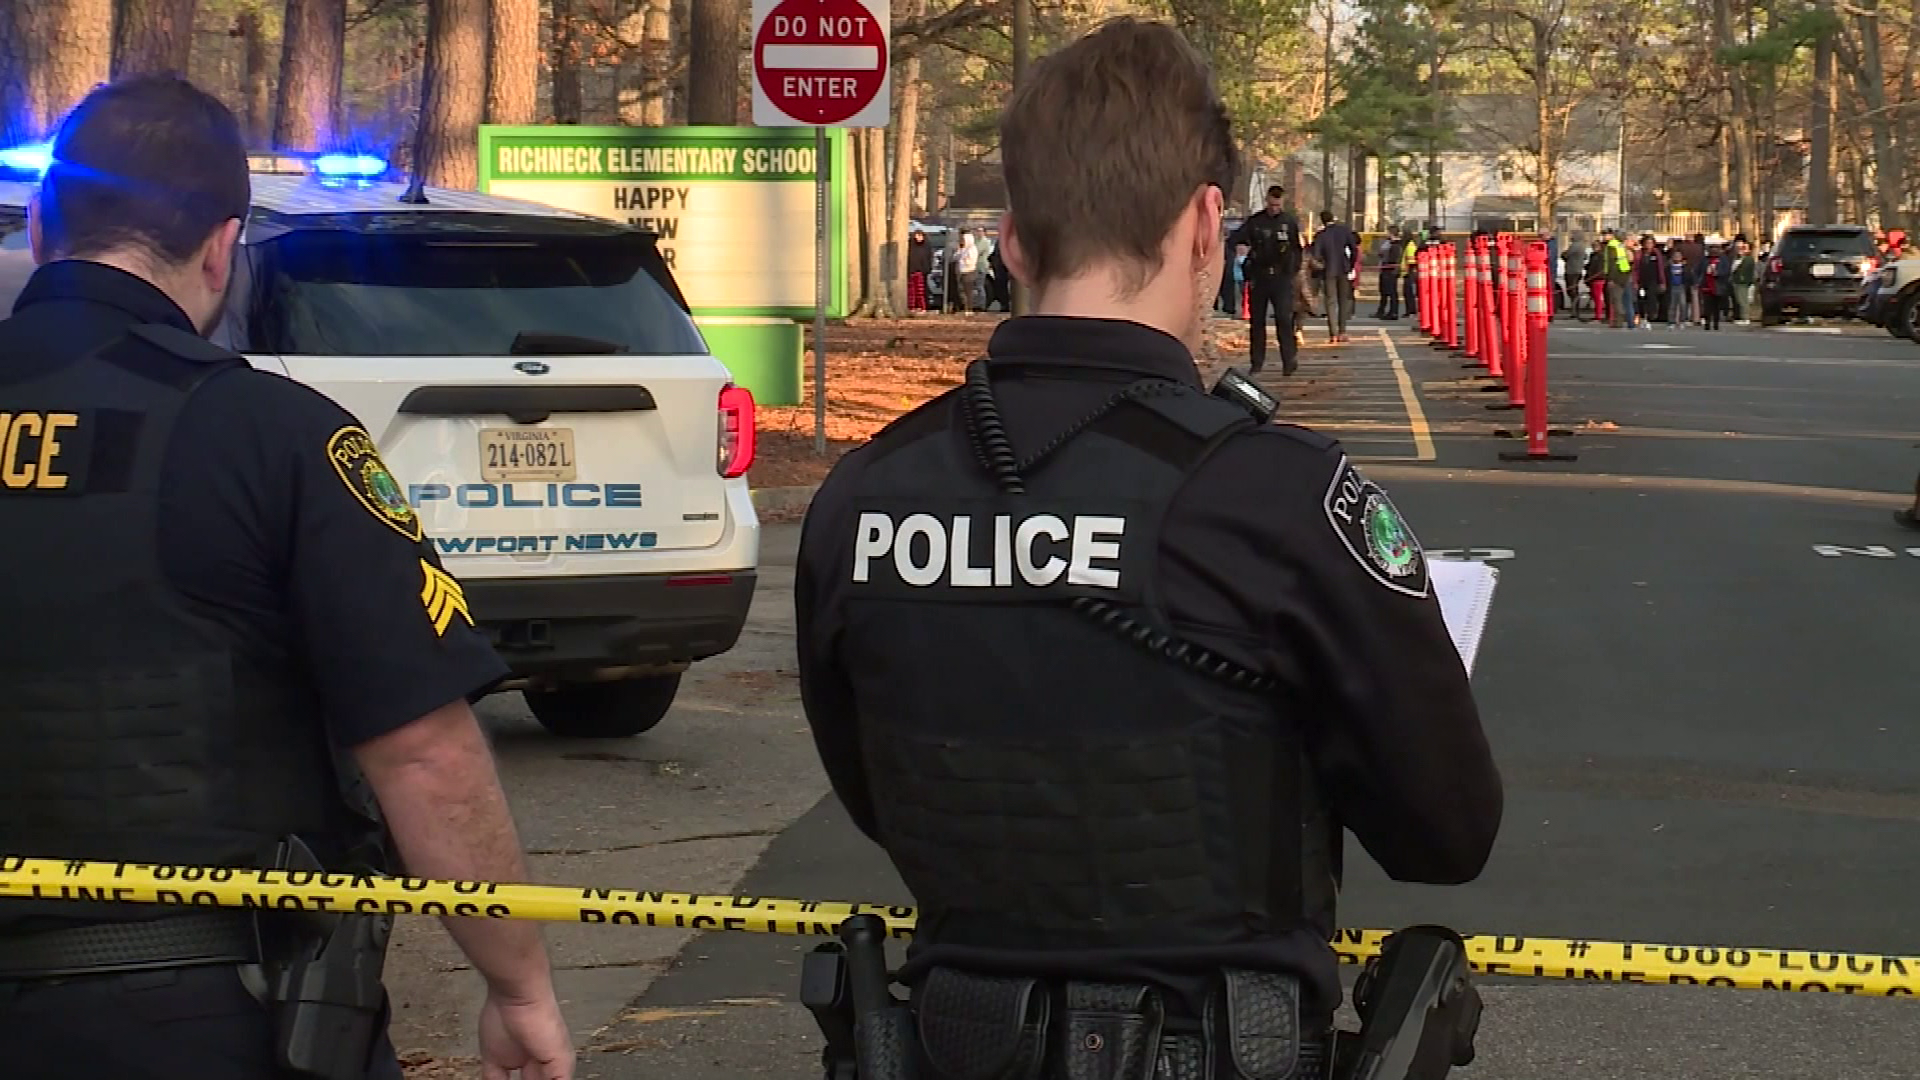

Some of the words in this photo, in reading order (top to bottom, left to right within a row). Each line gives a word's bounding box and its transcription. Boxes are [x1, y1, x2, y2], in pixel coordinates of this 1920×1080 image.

[775, 16, 807, 37] DO
[819, 17, 868, 38] NOT
[783, 77, 857, 98] ENTER
[498, 147, 602, 173] RICHNECK
[608, 147, 737, 174] ELEMENTARY
[614, 187, 689, 210] HAPPY
[505, 431, 550, 440] VIRGINIA
[408, 483, 642, 509] POLICE
[428, 535, 558, 553] WPORT
[565, 532, 657, 550] NEWS
[852, 512, 1125, 588] POLICE
